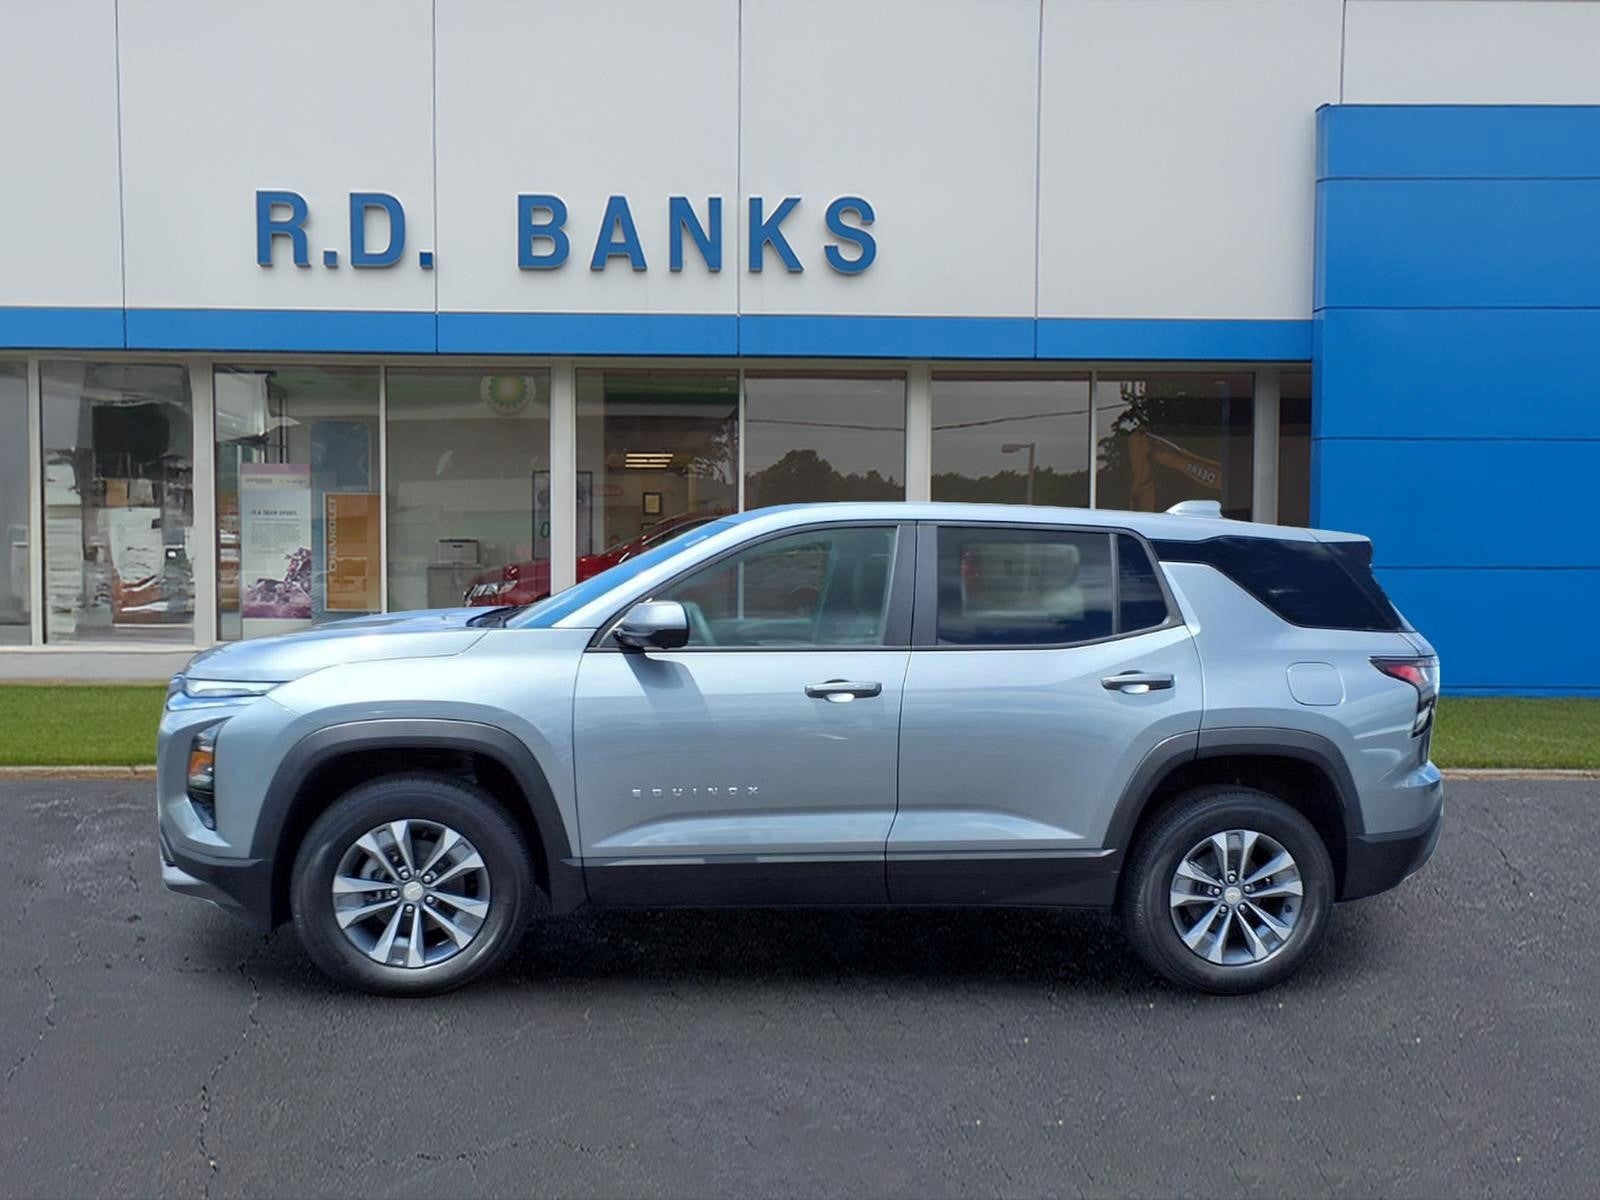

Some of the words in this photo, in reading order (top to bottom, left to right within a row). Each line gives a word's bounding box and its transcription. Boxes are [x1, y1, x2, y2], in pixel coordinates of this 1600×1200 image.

[256, 191, 433, 268] R.D.
[517, 194, 877, 273] BANKS
[328, 496, 337, 572] CHEVROLET
[631, 786, 759, 798] EQUINOX
